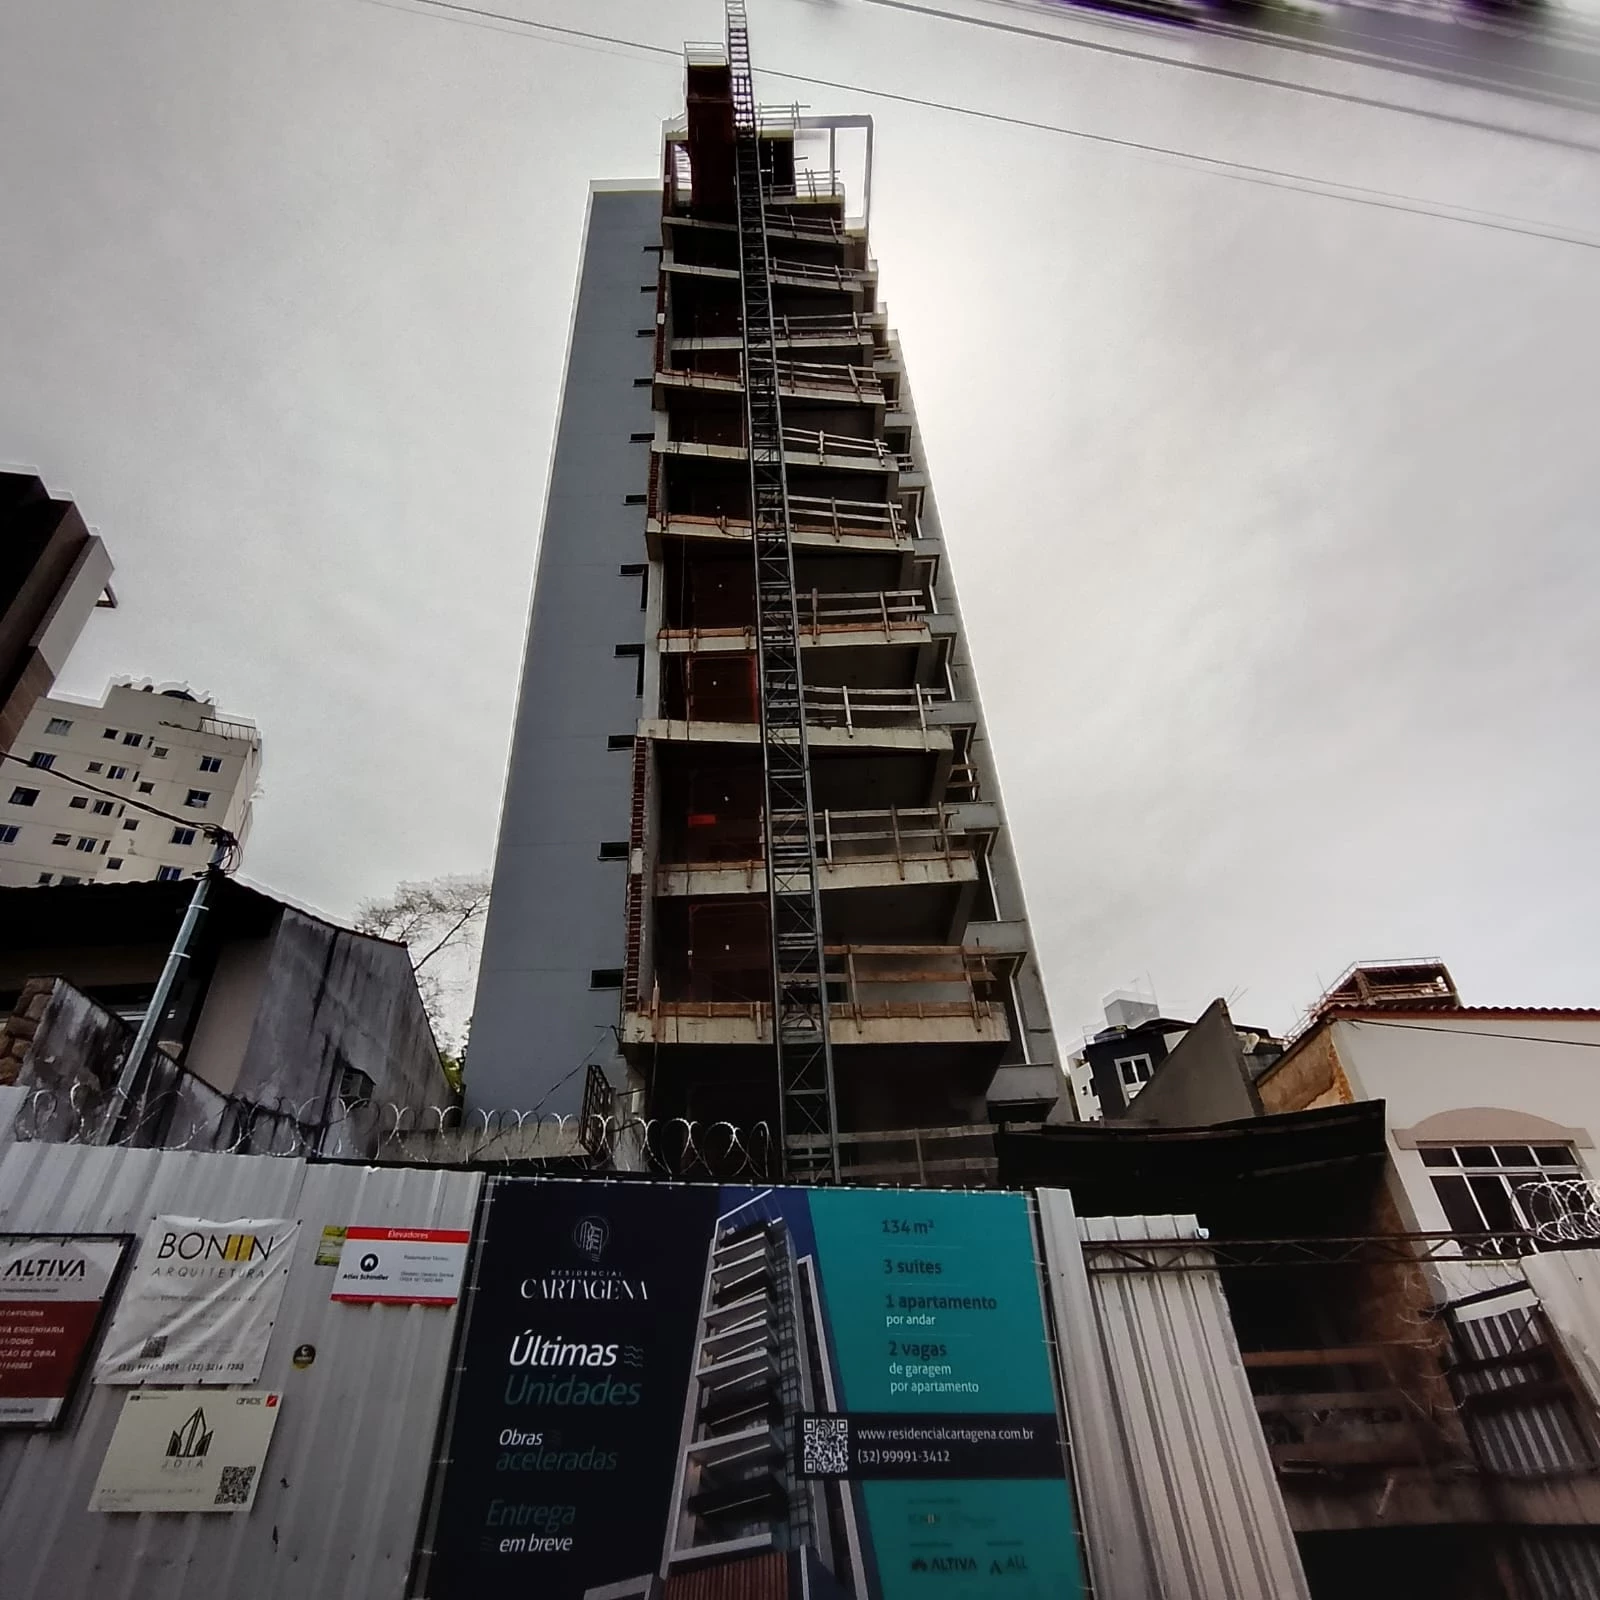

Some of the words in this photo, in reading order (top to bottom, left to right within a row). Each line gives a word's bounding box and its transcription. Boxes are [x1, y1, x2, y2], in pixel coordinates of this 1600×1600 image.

[882, 1219, 911, 1234] 134
[913, 1218, 934, 1234] m²
[388, 1230, 430, 1240] Elevadores
[5, 1259, 85, 1276] ALTIVA
[883, 1259, 894, 1274] 3
[520, 1278, 648, 1300] CARTAGENA
[886, 1293, 895, 1309] 1
[898, 1294, 997, 1312] apartamento
[886, 1315, 904, 1327] por
[906, 1313, 936, 1325] andar
[509, 1329, 619, 1366] Últimas
[888, 1340, 898, 1356] 2
[902, 1343, 947, 1361] vagas
[889, 1362, 903, 1374] de
[905, 1364, 952, 1378] garagem
[504, 1373, 642, 1406] Unidades
[890, 1382, 908, 1396] por
[911, 1381, 979, 1395] apartamento
[499, 1428, 544, 1446] Obras
[857, 1427, 1034, 1443] www.residencialcartagena.com.br
[496, 1444, 619, 1471] aceleradas
[857, 1449, 880, 1464] (32)
[882, 1450, 950, 1464] 99991-3412
[485, 1499, 576, 1534] Entrega
[499, 1538, 526, 1552] em
[528, 1533, 573, 1552] breve
[931, 1557, 977, 1570] ALTIVA
